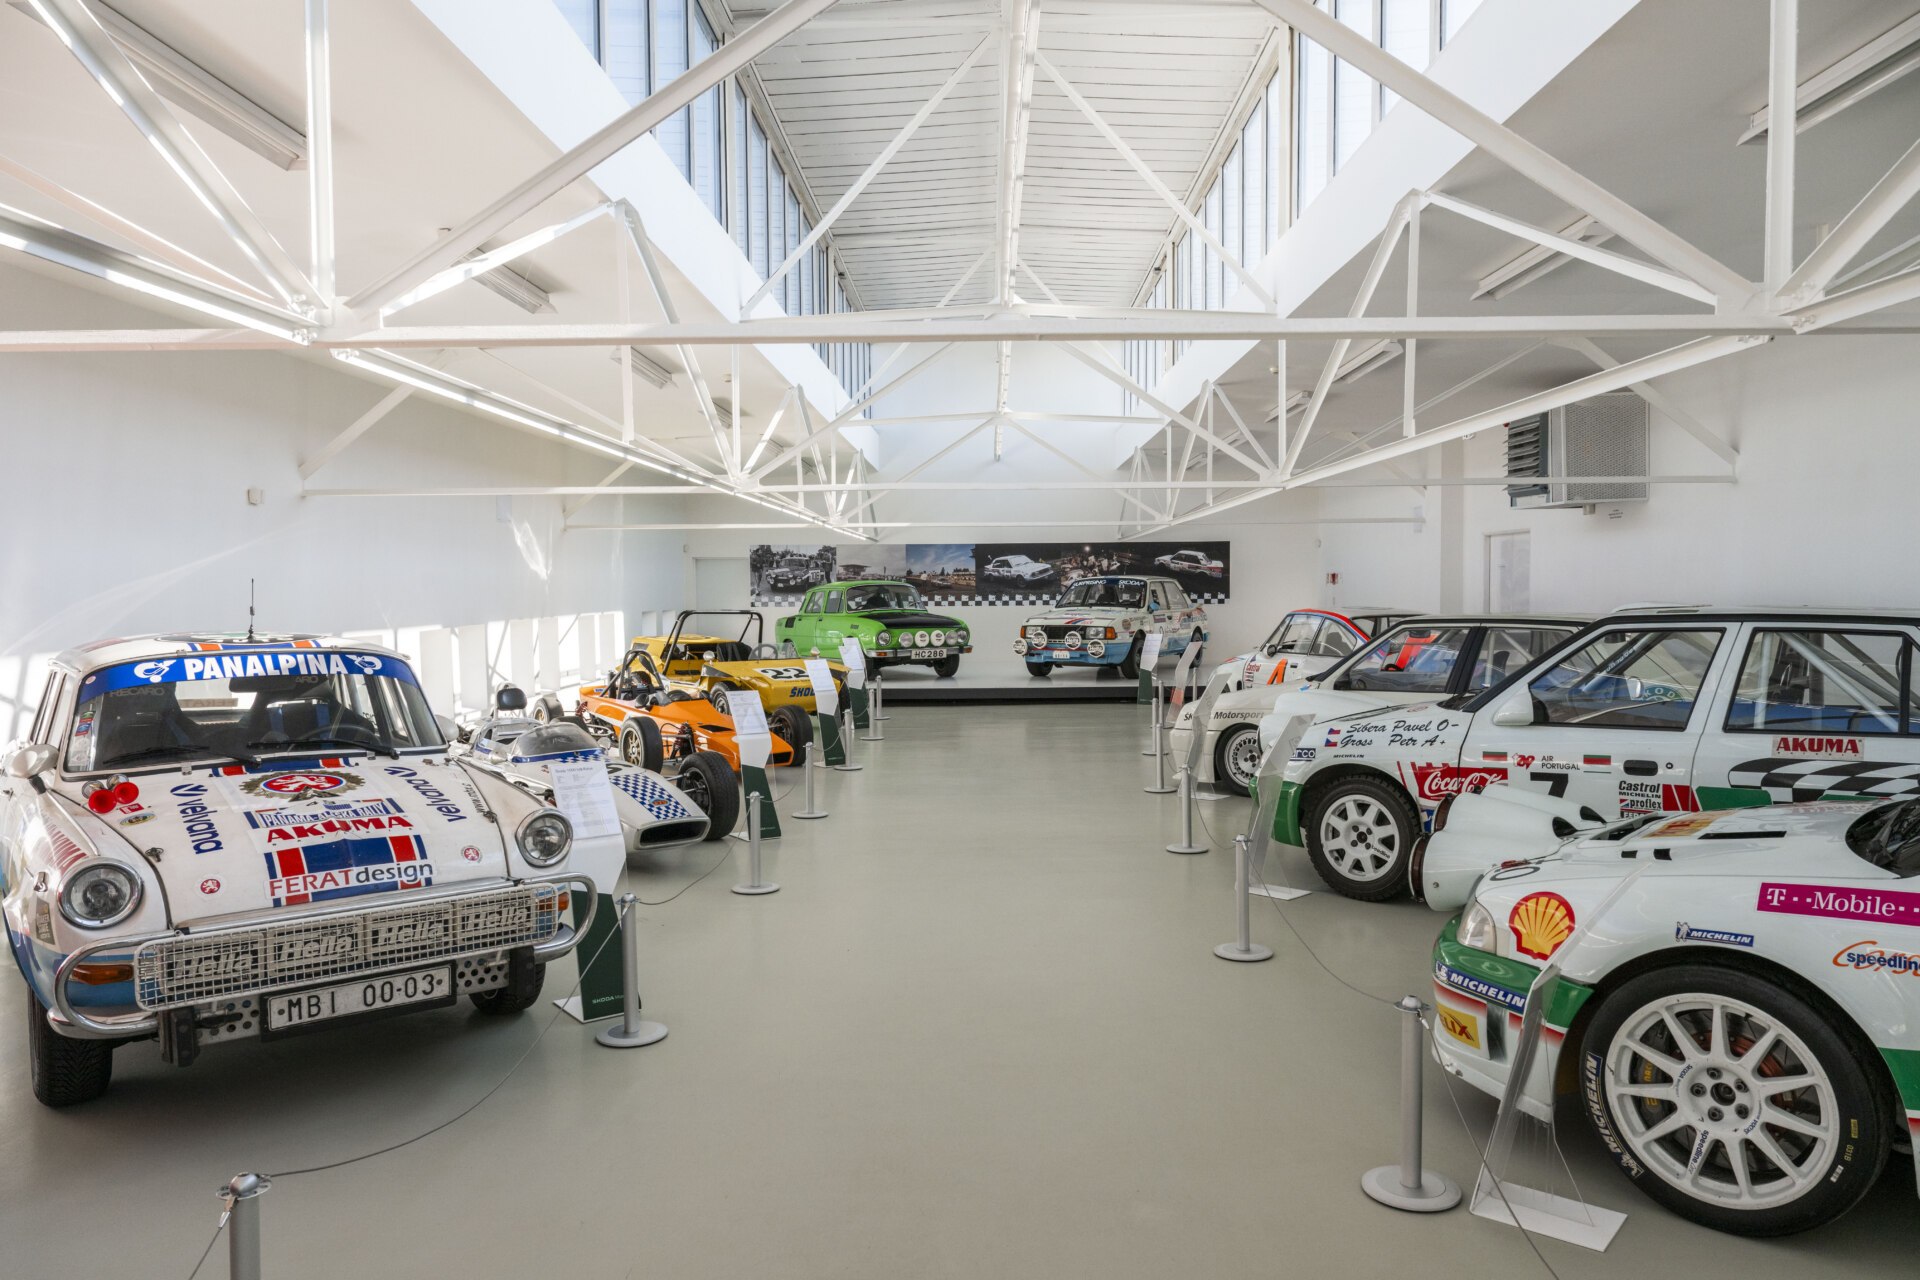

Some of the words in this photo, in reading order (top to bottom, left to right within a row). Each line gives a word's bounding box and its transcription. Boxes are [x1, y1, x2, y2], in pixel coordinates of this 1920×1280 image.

[184, 654, 349, 680] PANALPINA
[110, 687, 165, 697] RECARO
[1214, 711, 1264, 721] Motorsport
[1391, 721, 1432, 733] Pavel
[1340, 735, 1373, 748] Gross
[1389, 734, 1417, 747] Petr
[1776, 737, 1860, 754] AKUMA
[1541, 763, 1580, 771] PORTUGAL
[1618, 781, 1661, 793] Castrol
[1619, 791, 1661, 799] MICHELIN
[404, 778, 467, 822] velvand
[1630, 799, 1662, 810] proflex
[177, 798, 223, 855] velvand
[264, 808, 357, 827] PANAMA-ALASKA
[358, 803, 386, 818] RALLY
[267, 816, 414, 843] AKUMA
[466, 906, 528, 932] Hella
[377, 920, 445, 945] Hella
[1690, 930, 1752, 944] MICHELIN
[280, 935, 353, 961] Hella
[173, 953, 253, 979] Hella
[1846, 951, 1920, 972] speedlin
[363, 973, 435, 1007] 00-03
[1449, 973, 1526, 1007] MICHELIN
[1586, 1054, 1622, 1153] MICHELIN
[1694, 1130, 1709, 1164] speedline
